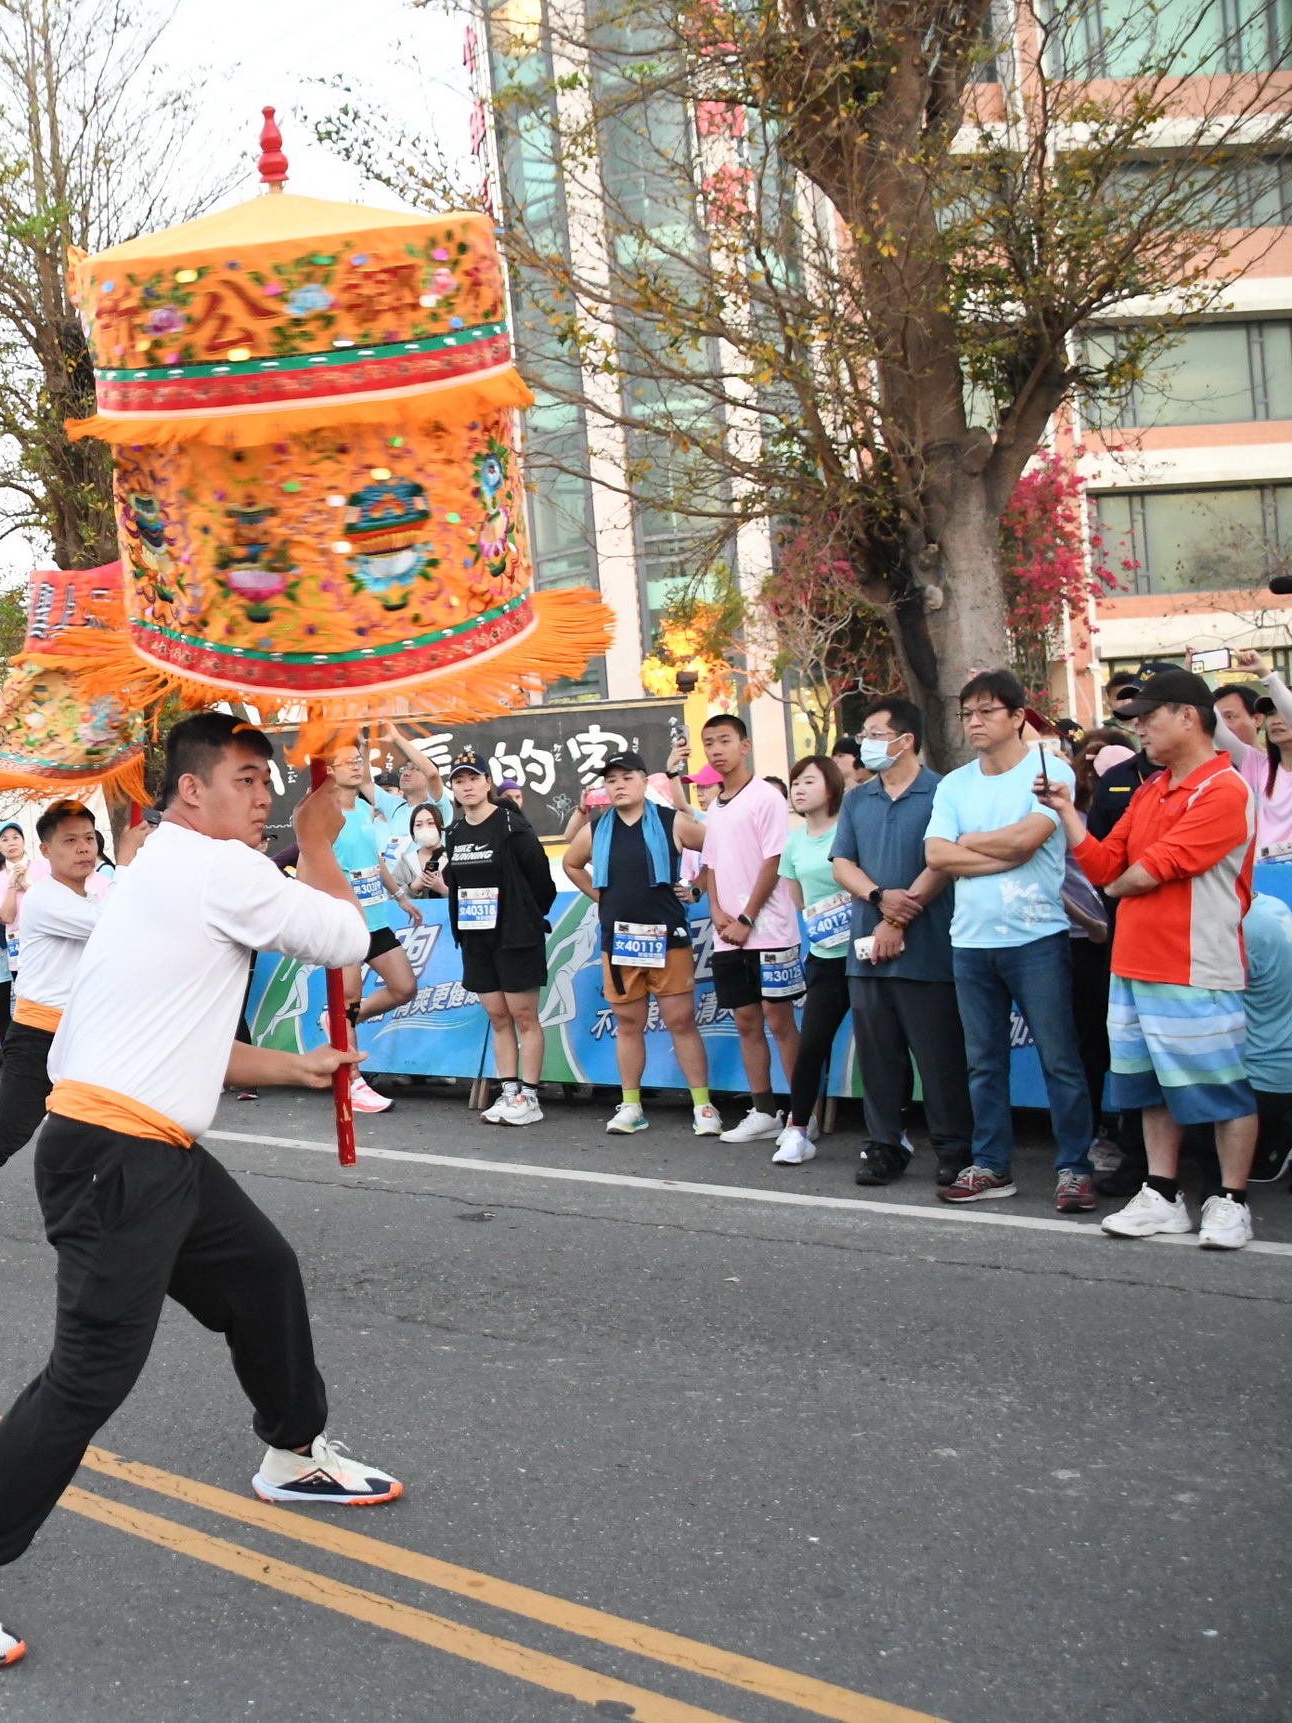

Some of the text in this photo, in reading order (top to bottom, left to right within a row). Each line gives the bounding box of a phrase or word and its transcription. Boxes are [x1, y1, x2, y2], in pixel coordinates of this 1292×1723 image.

[453, 844, 475, 853] NIKE
[451, 850, 494, 862] RUNNING
[615, 940, 664, 953] 女40119
